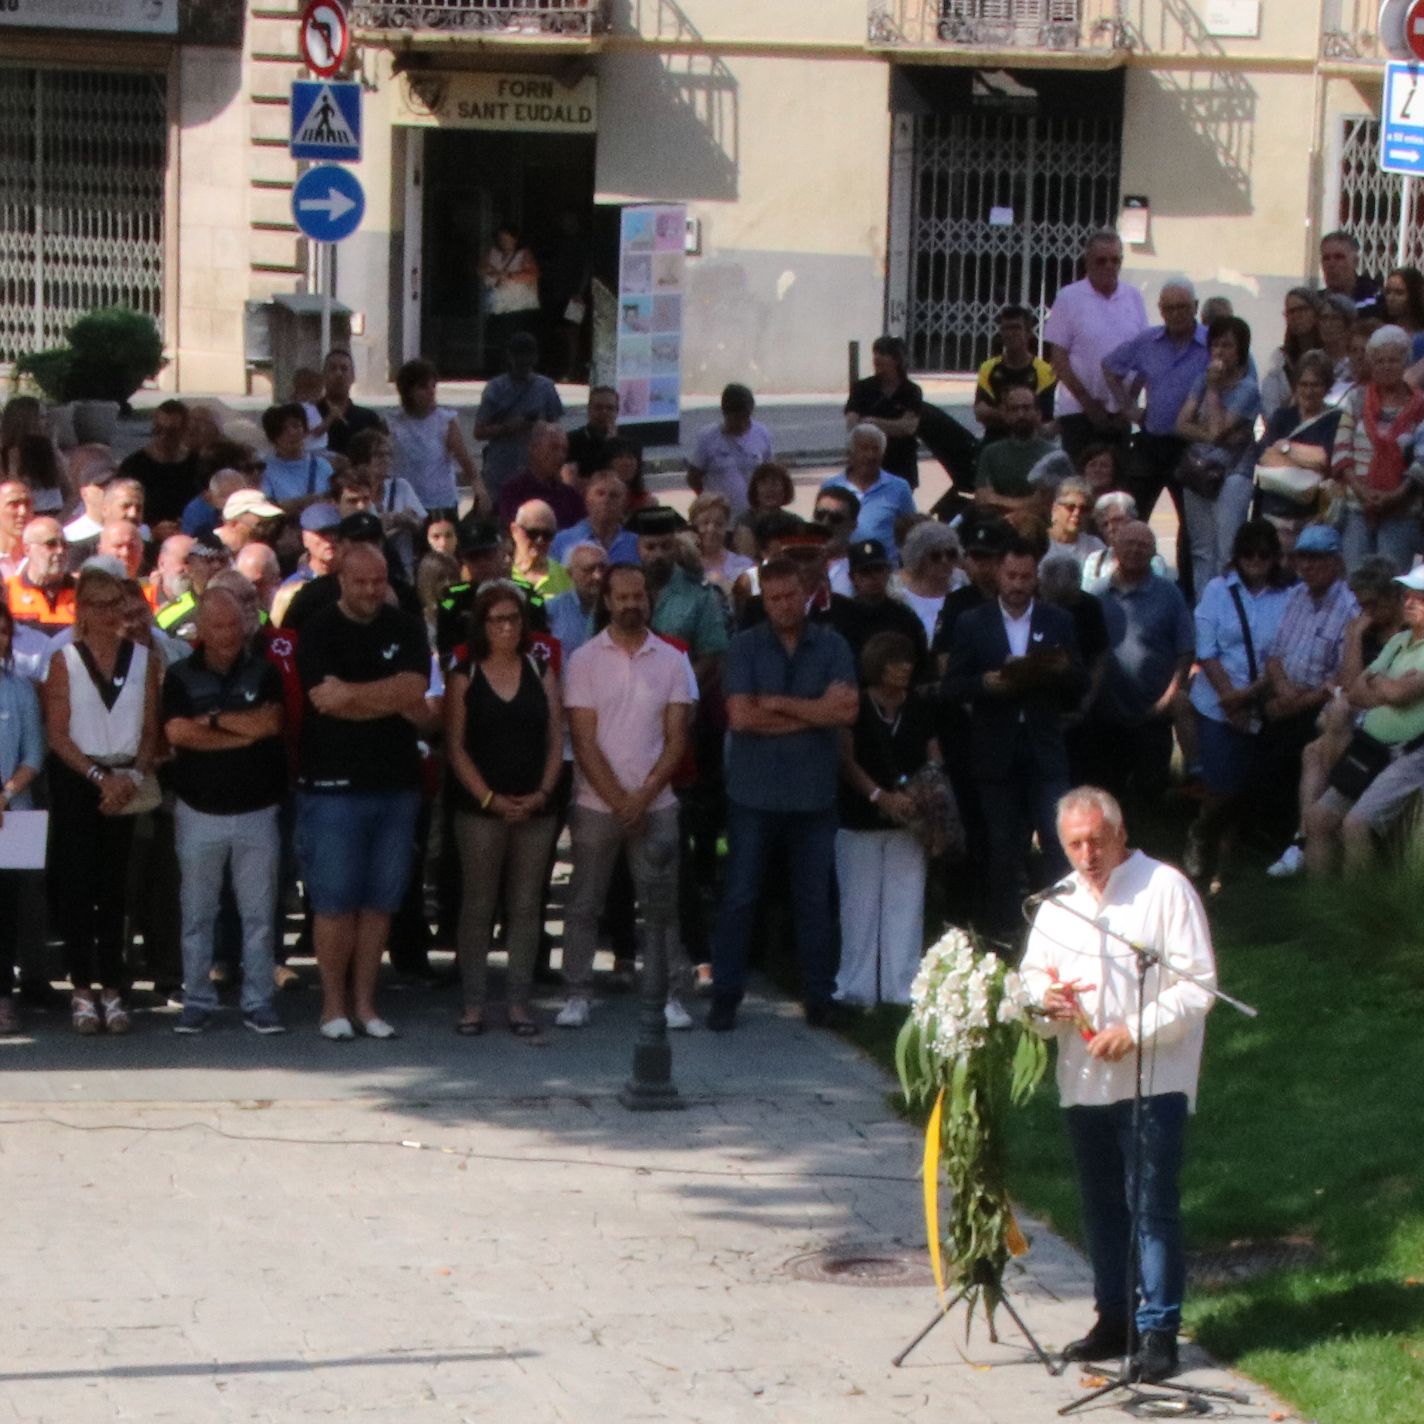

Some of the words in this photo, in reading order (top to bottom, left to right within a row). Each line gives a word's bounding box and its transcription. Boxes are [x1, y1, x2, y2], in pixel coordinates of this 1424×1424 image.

[497, 80, 553, 98] FORN
[458, 102, 509, 121] SANT
[514, 103, 592, 123] EUDALD
